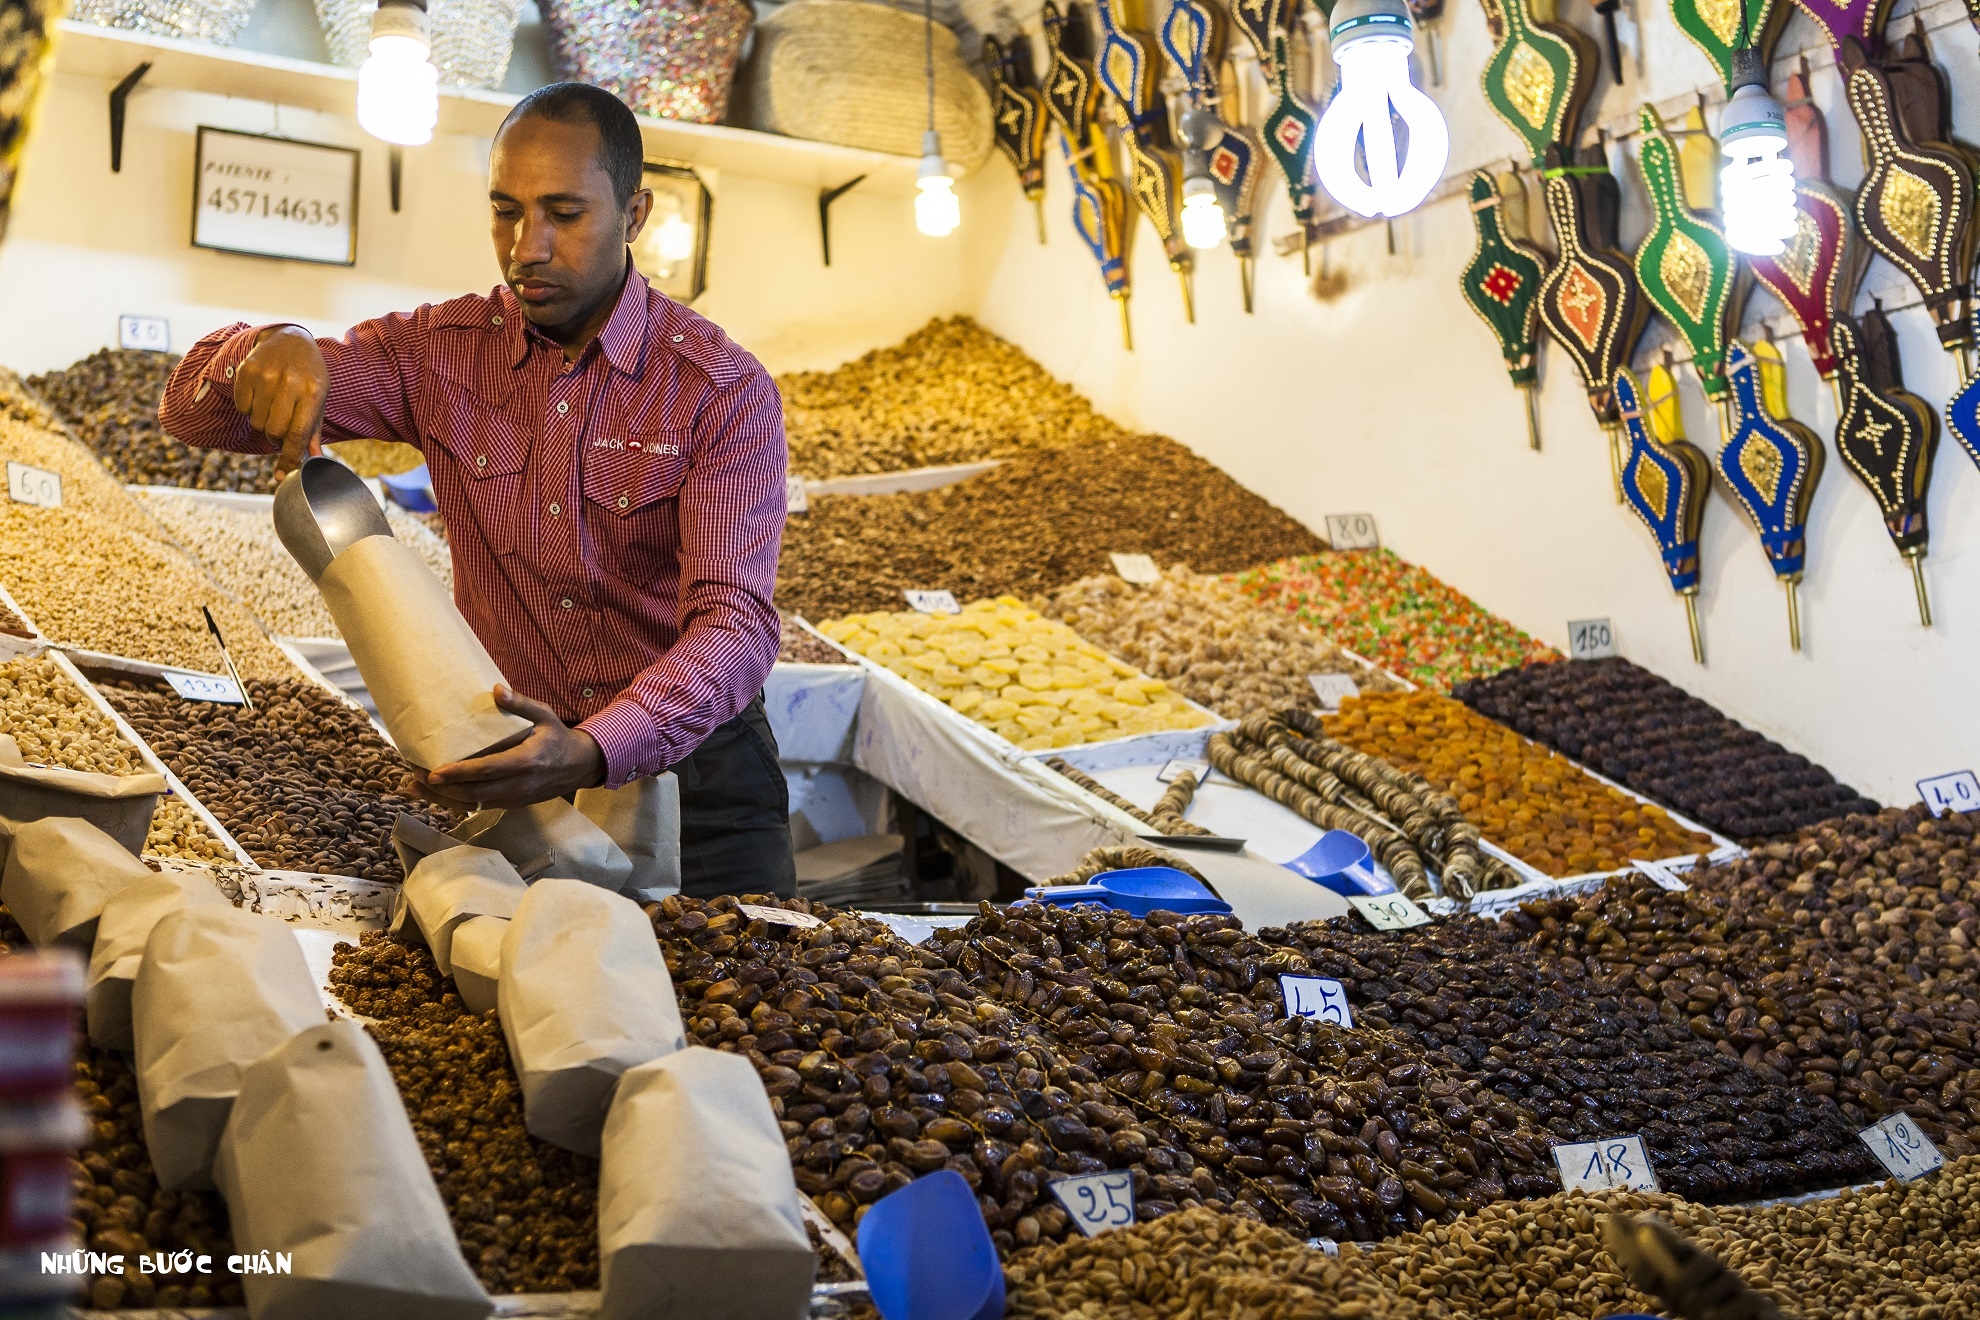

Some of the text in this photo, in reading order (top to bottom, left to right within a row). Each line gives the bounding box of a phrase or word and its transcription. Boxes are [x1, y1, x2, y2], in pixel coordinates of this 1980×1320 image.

[207, 186, 340, 228] 45714635
[594, 437, 680, 456] JACK JONES
[22, 471, 53, 500] 60
[1576, 624, 1611, 652] 150
[183, 679, 227, 693] 130
[1934, 782, 1970, 806] 40
[1368, 901, 1409, 921] 90
[1294, 986, 1342, 1024] 45
[1885, 1122, 1921, 1164] 12
[1582, 1144, 1632, 1180] 18
[1077, 1180, 1131, 1225] 25
